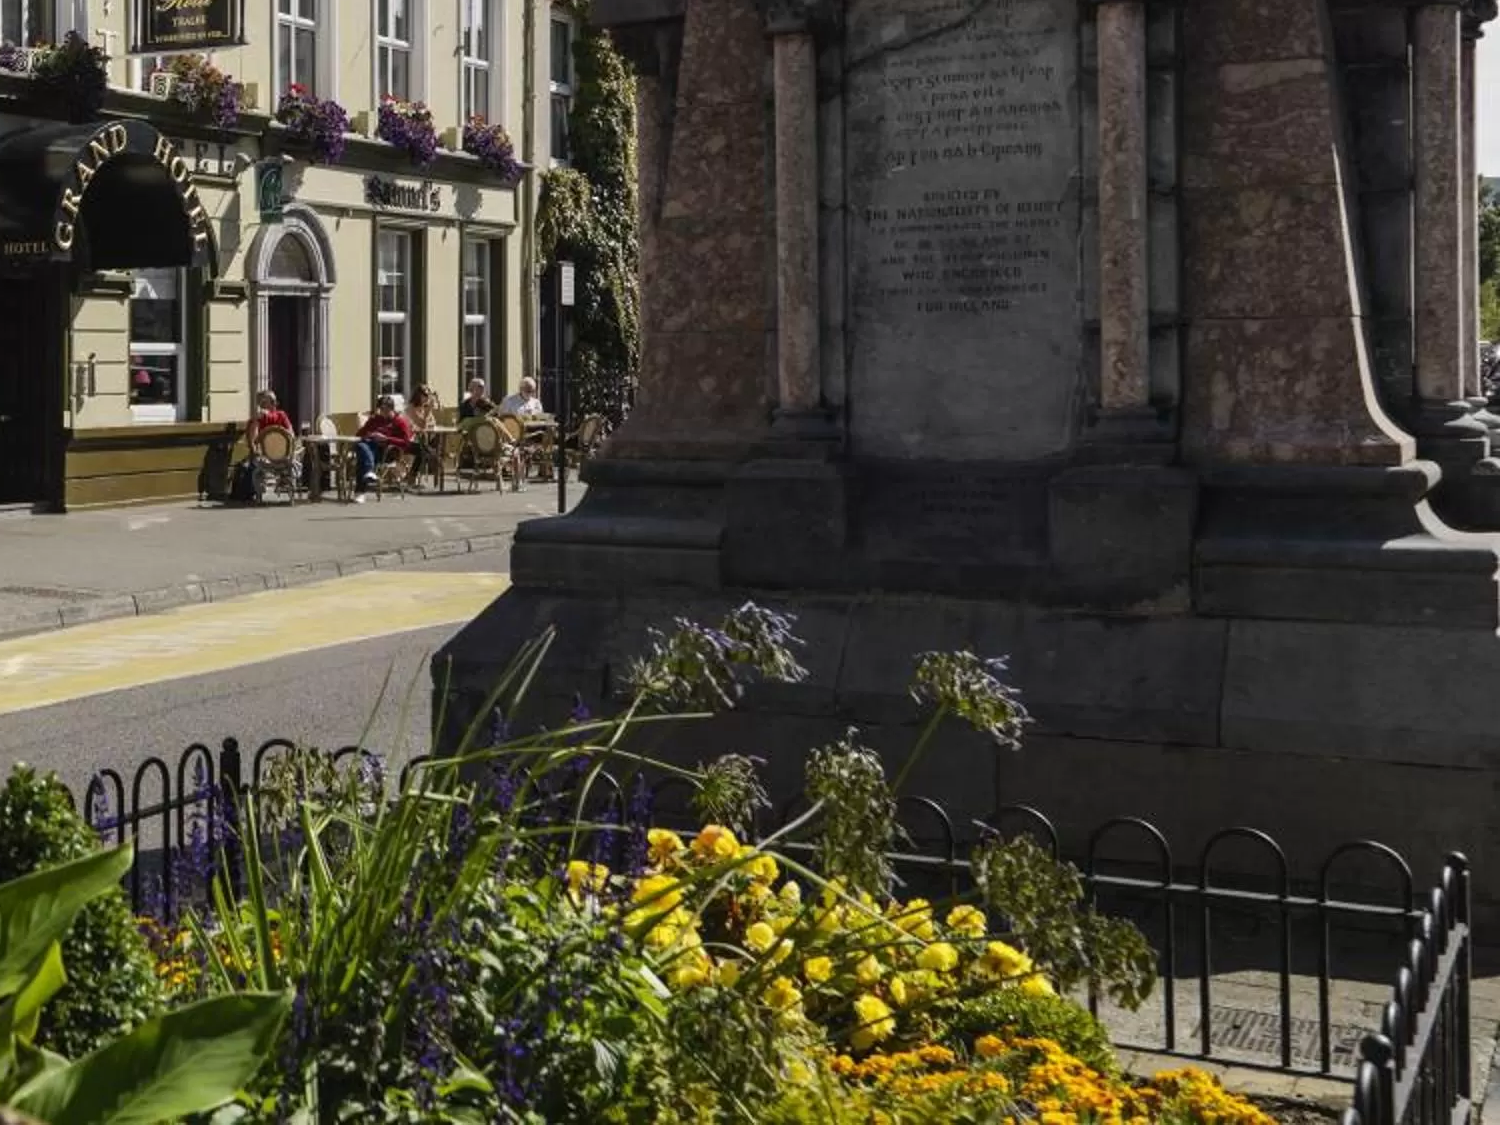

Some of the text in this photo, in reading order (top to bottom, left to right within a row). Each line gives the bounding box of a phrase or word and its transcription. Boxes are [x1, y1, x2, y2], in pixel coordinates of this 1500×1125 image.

[55, 124, 208, 251] GRAND HOTEL
[3, 241, 50, 256] HOTEL
